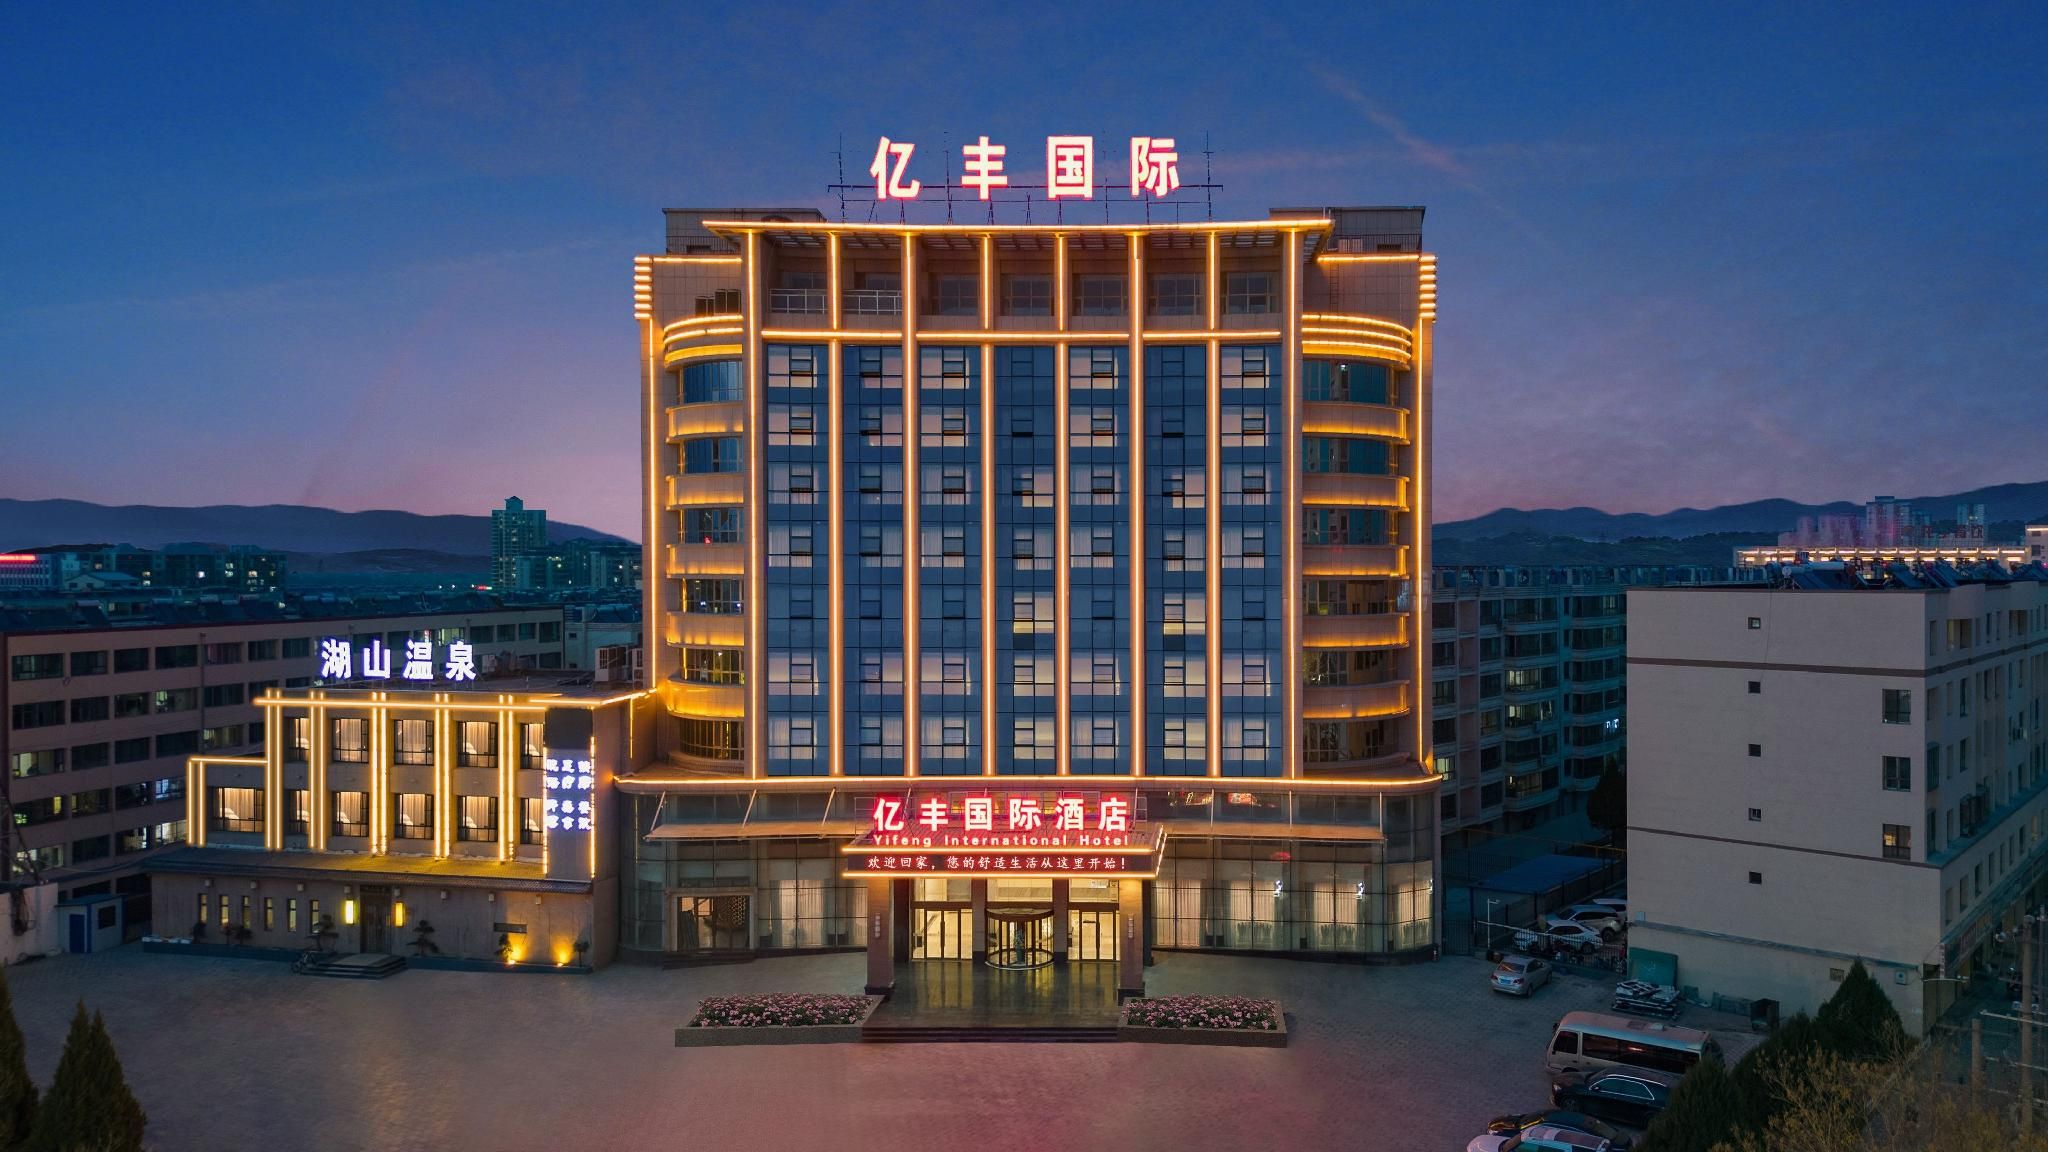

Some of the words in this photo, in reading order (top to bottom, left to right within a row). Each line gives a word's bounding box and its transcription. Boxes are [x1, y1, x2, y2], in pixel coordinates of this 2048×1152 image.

[869, 136, 1180, 199] 亿丰国际
[321, 639, 476, 681] 湖山温泉
[873, 798, 1128, 831] 亿丰国际酒店
[873, 835, 932, 847] Yifeng
[945, 834, 1067, 846] International
[1080, 834, 1128, 846] Hotel
